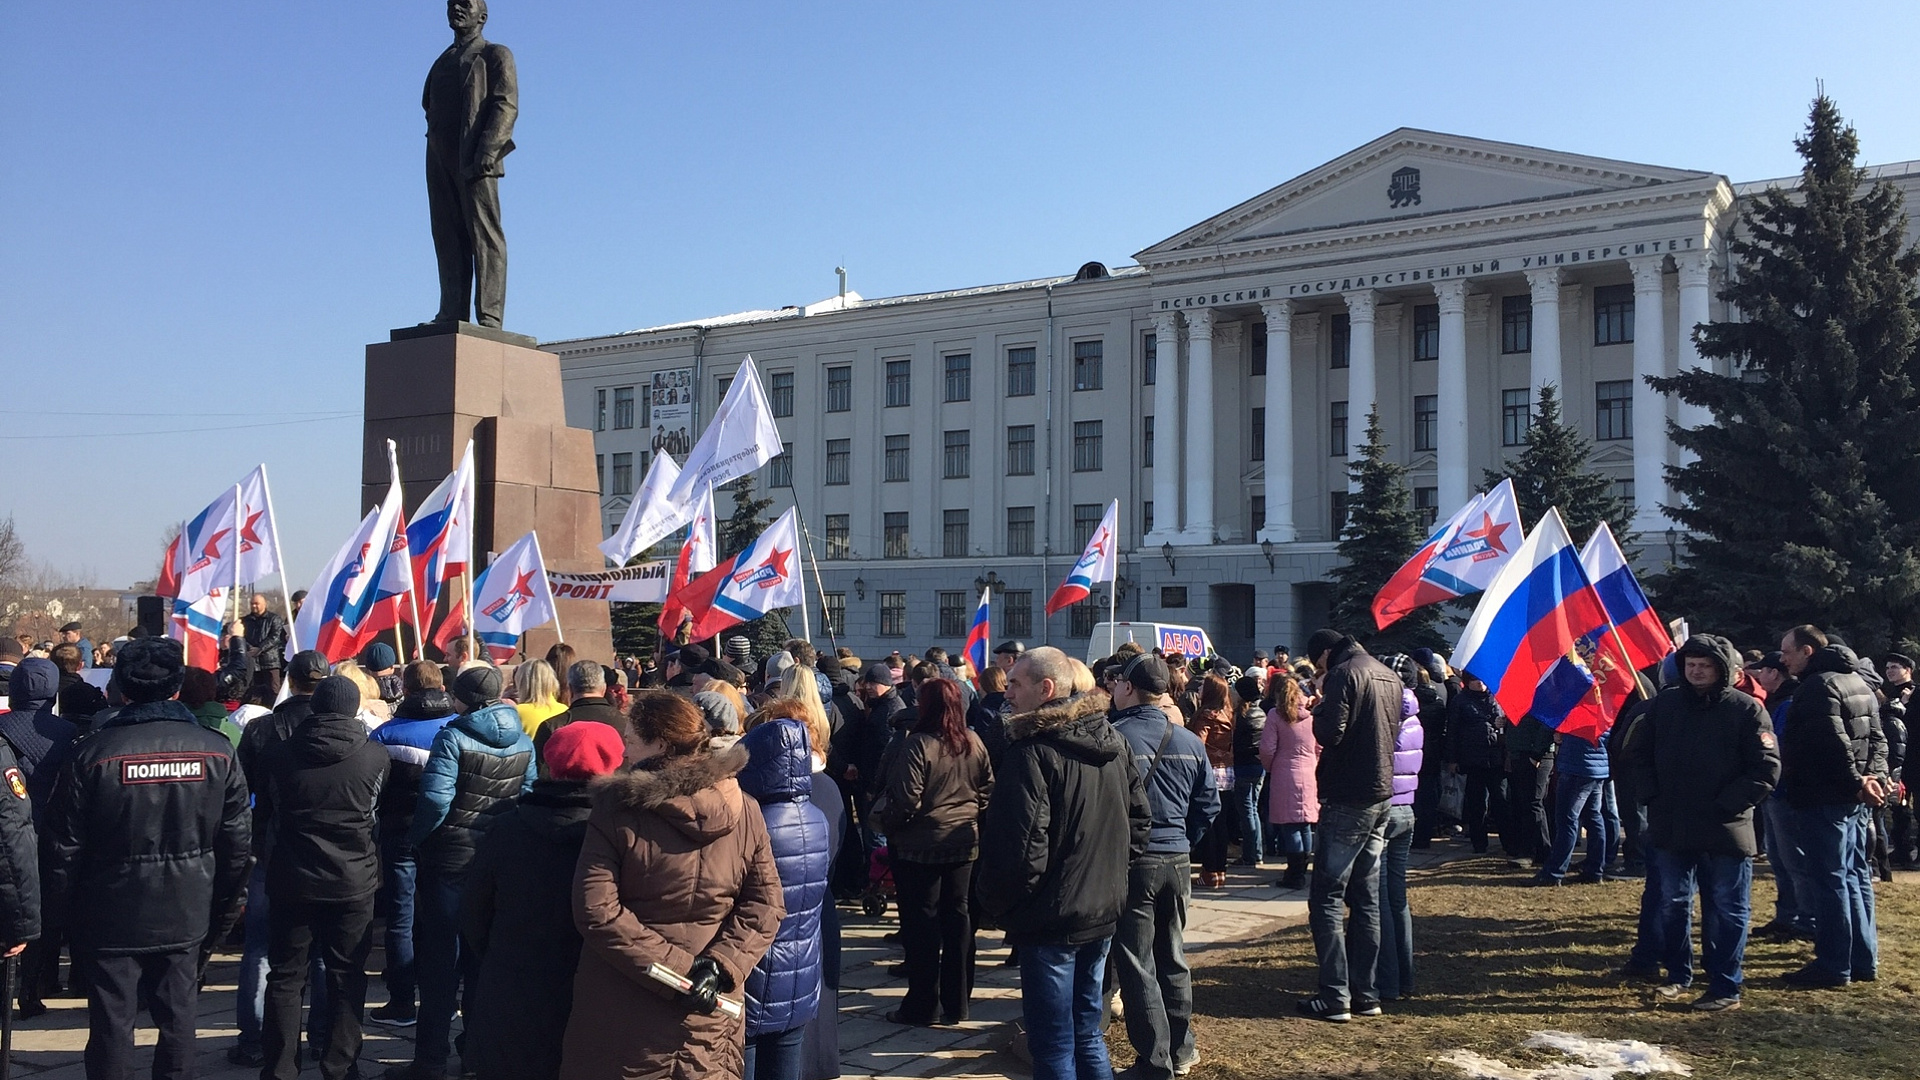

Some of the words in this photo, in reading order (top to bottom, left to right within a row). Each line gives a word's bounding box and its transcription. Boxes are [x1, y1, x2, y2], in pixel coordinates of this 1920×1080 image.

[1160, 286, 1271, 310] ПСКОВСКИЙ
[1289, 259, 1500, 295] ГОСУДАРСТВЕННЫЙ
[1522, 238, 1693, 268] УНИВЕРСИТЕТ
[1163, 632, 1203, 656] ДЕЛО
[127, 762, 201, 779] ПОЛИЦИЯ
